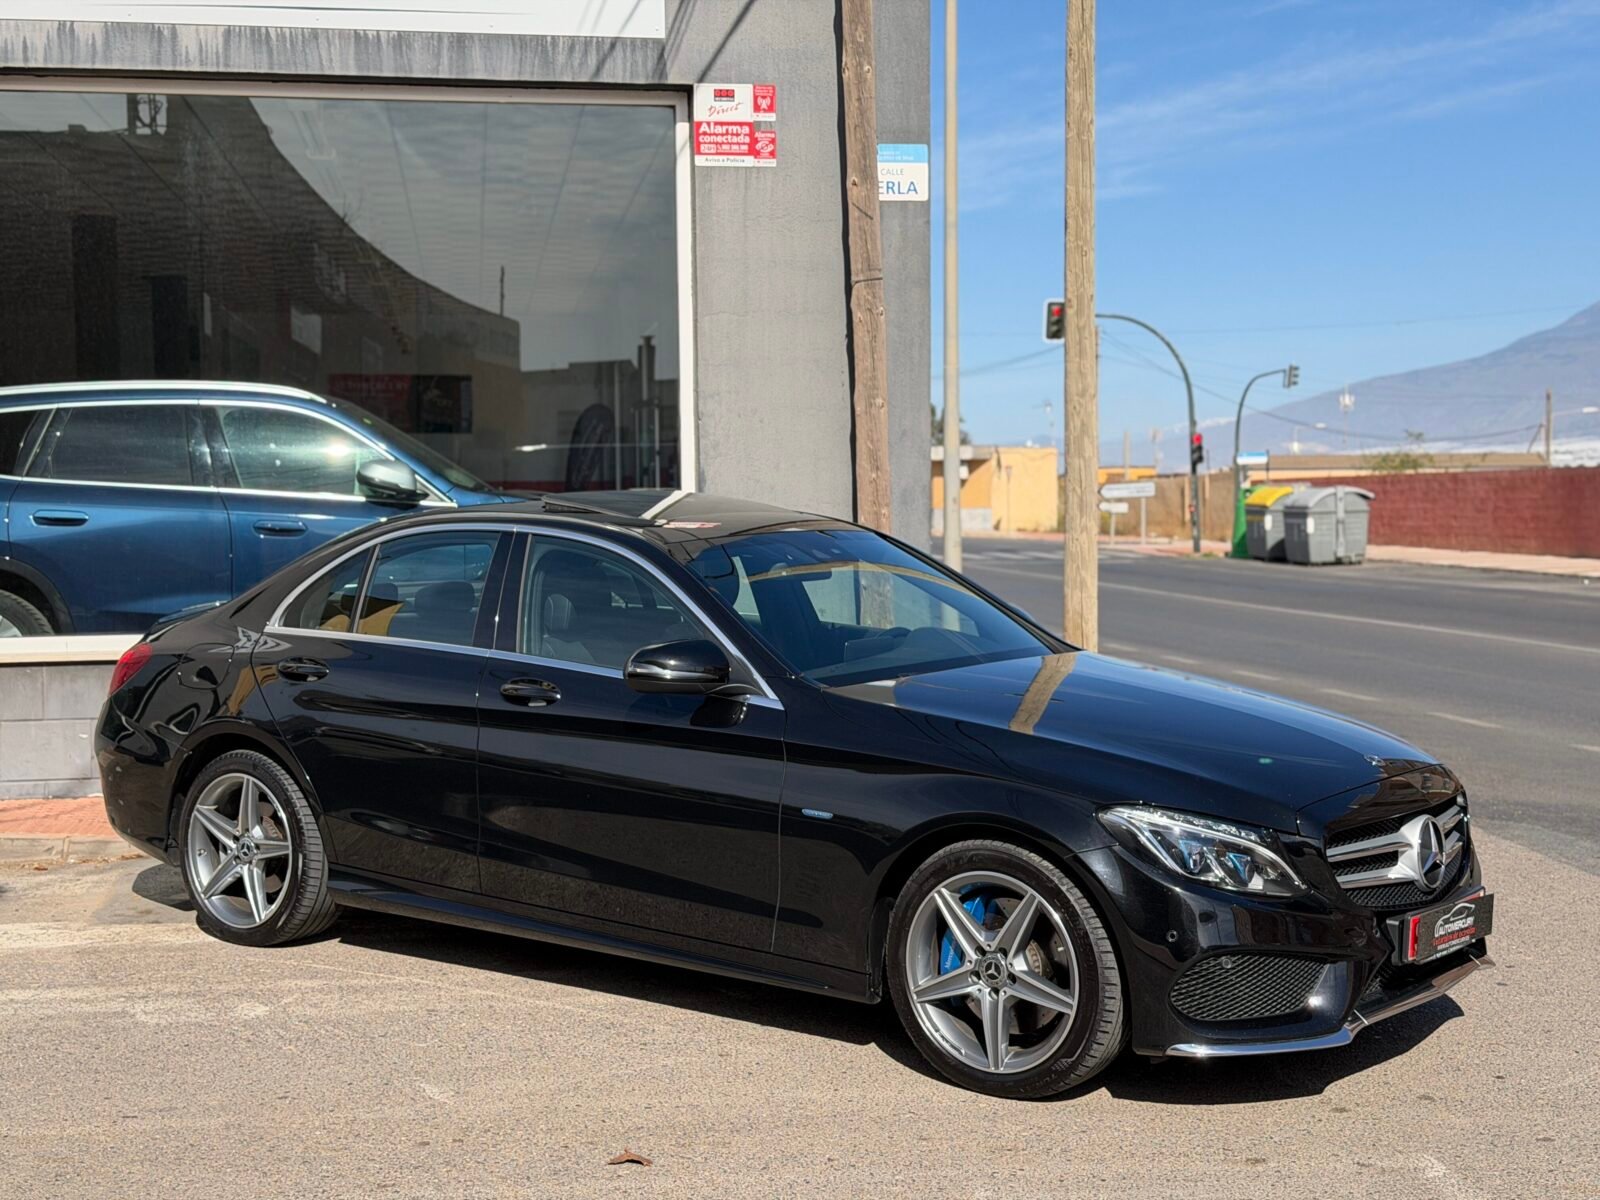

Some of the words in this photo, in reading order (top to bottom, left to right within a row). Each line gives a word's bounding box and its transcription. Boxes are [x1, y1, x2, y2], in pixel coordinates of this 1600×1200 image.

[699, 122, 750, 134] Alarma
[699, 134, 750, 143] conectada
[880, 168, 904, 176] CALLE
